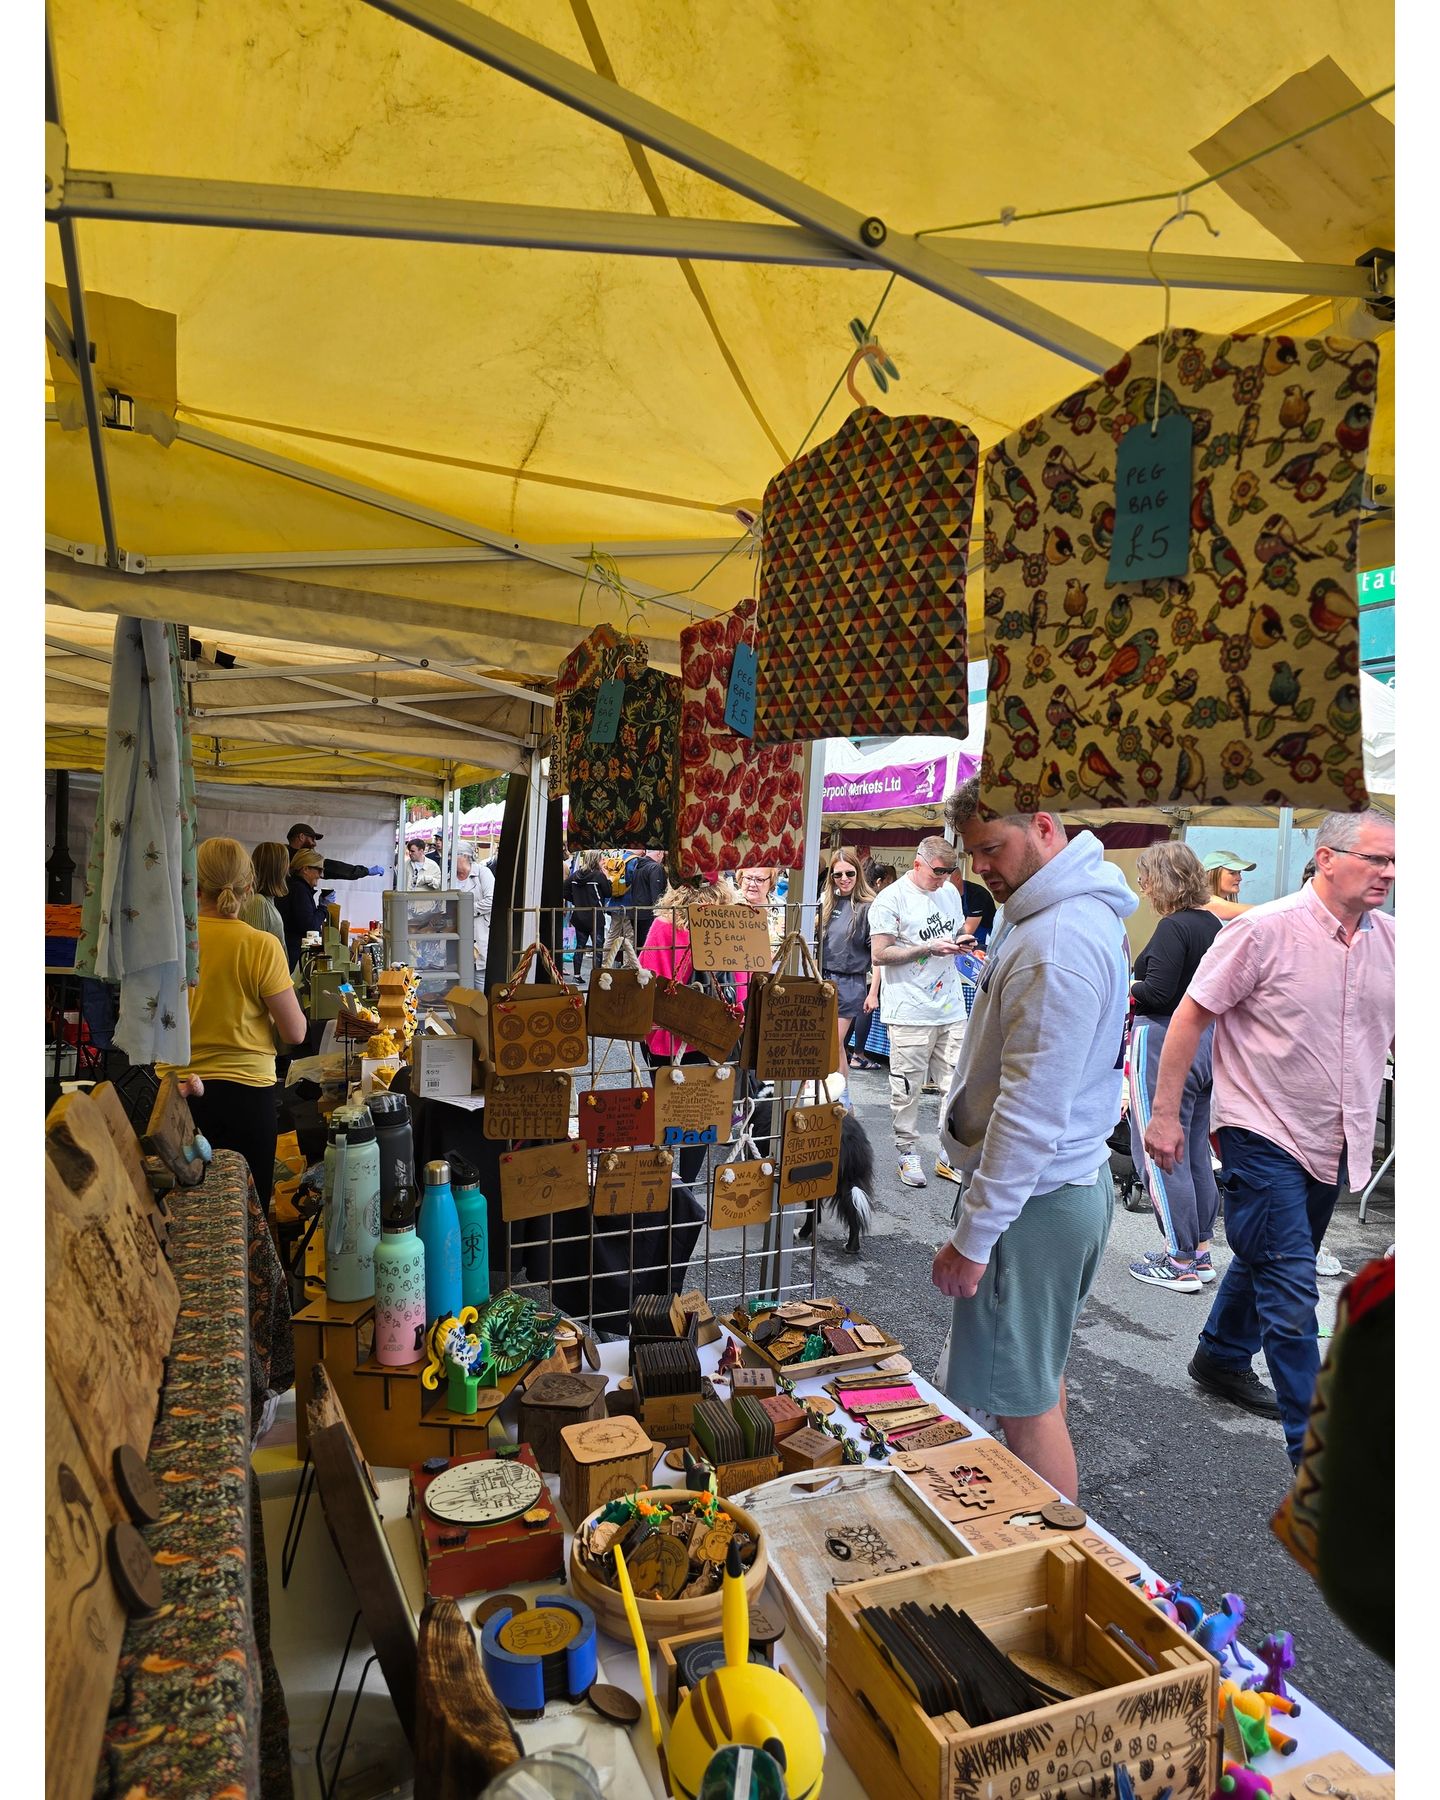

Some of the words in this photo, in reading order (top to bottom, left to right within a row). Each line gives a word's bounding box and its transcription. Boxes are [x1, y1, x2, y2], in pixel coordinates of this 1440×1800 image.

[1126, 463, 1167, 487] PEG
[1128, 489, 1169, 514] BAG
[1125, 523, 1170, 568] £5
[737, 668, 753, 686] PEG
[733, 683, 751, 702] BAG
[731, 699, 748, 725] £5
[849, 777, 883, 797] Markets
[884, 776, 901, 792] Ltd
[704, 907, 755, 919] ENGRAVED
[691, 918, 735, 929] WOODEN
[738, 920, 767, 932] SIGNS
[703, 930, 722, 946] £5
[724, 933, 746, 942] EACH
[733, 945, 745, 953] OR
[704, 950, 715, 967] 3
[722, 957, 738, 966] FOR
[743, 953, 766, 970] £10
[774, 1019, 817, 1031] STARS
[788, 1040, 820, 1058] them
[765, 1067, 796, 1078] ALWAYS
[520, 1094, 541, 1103] ONE
[543, 1094, 563, 1103] YES
[487, 1116, 563, 1138] COFFEE?
[664, 1125, 718, 1146] Dad
[807, 1135, 833, 1148] WI-FI
[784, 1147, 839, 1166] PASSWORD
[721, 1171, 765, 1193] HWARTS
[720, 1199, 763, 1219] QUIDDITCH
[896, 1453, 919, 1469] £10
[1052, 1505, 1077, 1524] £10
[1083, 1537, 1127, 1568] DAD
